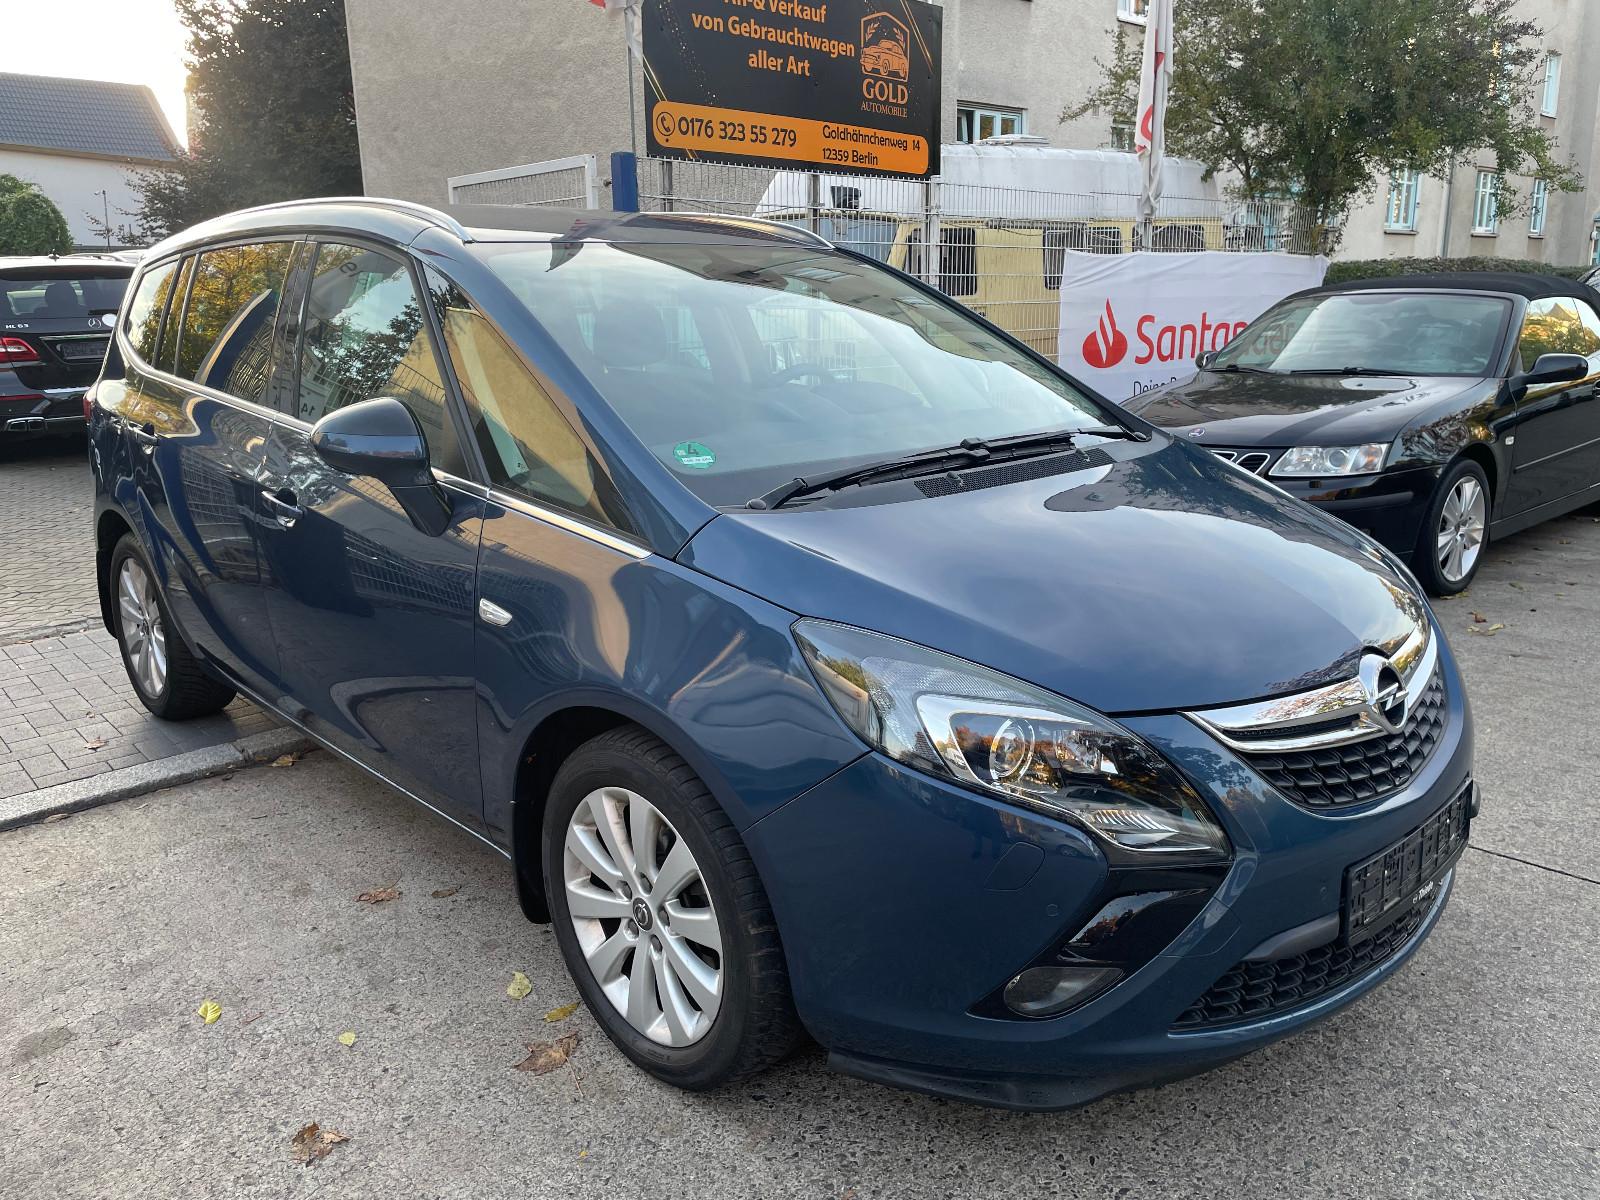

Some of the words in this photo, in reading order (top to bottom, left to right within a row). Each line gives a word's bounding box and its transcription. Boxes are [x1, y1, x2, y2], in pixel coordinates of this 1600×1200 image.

[769, 0, 826, 22] Verkauf
[692, 13, 724, 33] von
[728, 16, 855, 58] Gebrauchtwagen
[748, 50, 784, 71] aller
[787, 51, 810, 76] Art
[862, 78, 908, 104] GOLD
[861, 101, 908, 118] AUTOMOBILE
[678, 117, 714, 138] 0176
[719, 122, 746, 142] 323
[750, 125, 768, 143] 55
[772, 128, 797, 147] 279
[822, 125, 908, 150] Goldhähnchenweg
[912, 140, 921, 151] 14
[822, 148, 850, 162] 12359
[851, 150, 879, 166] Berlin
